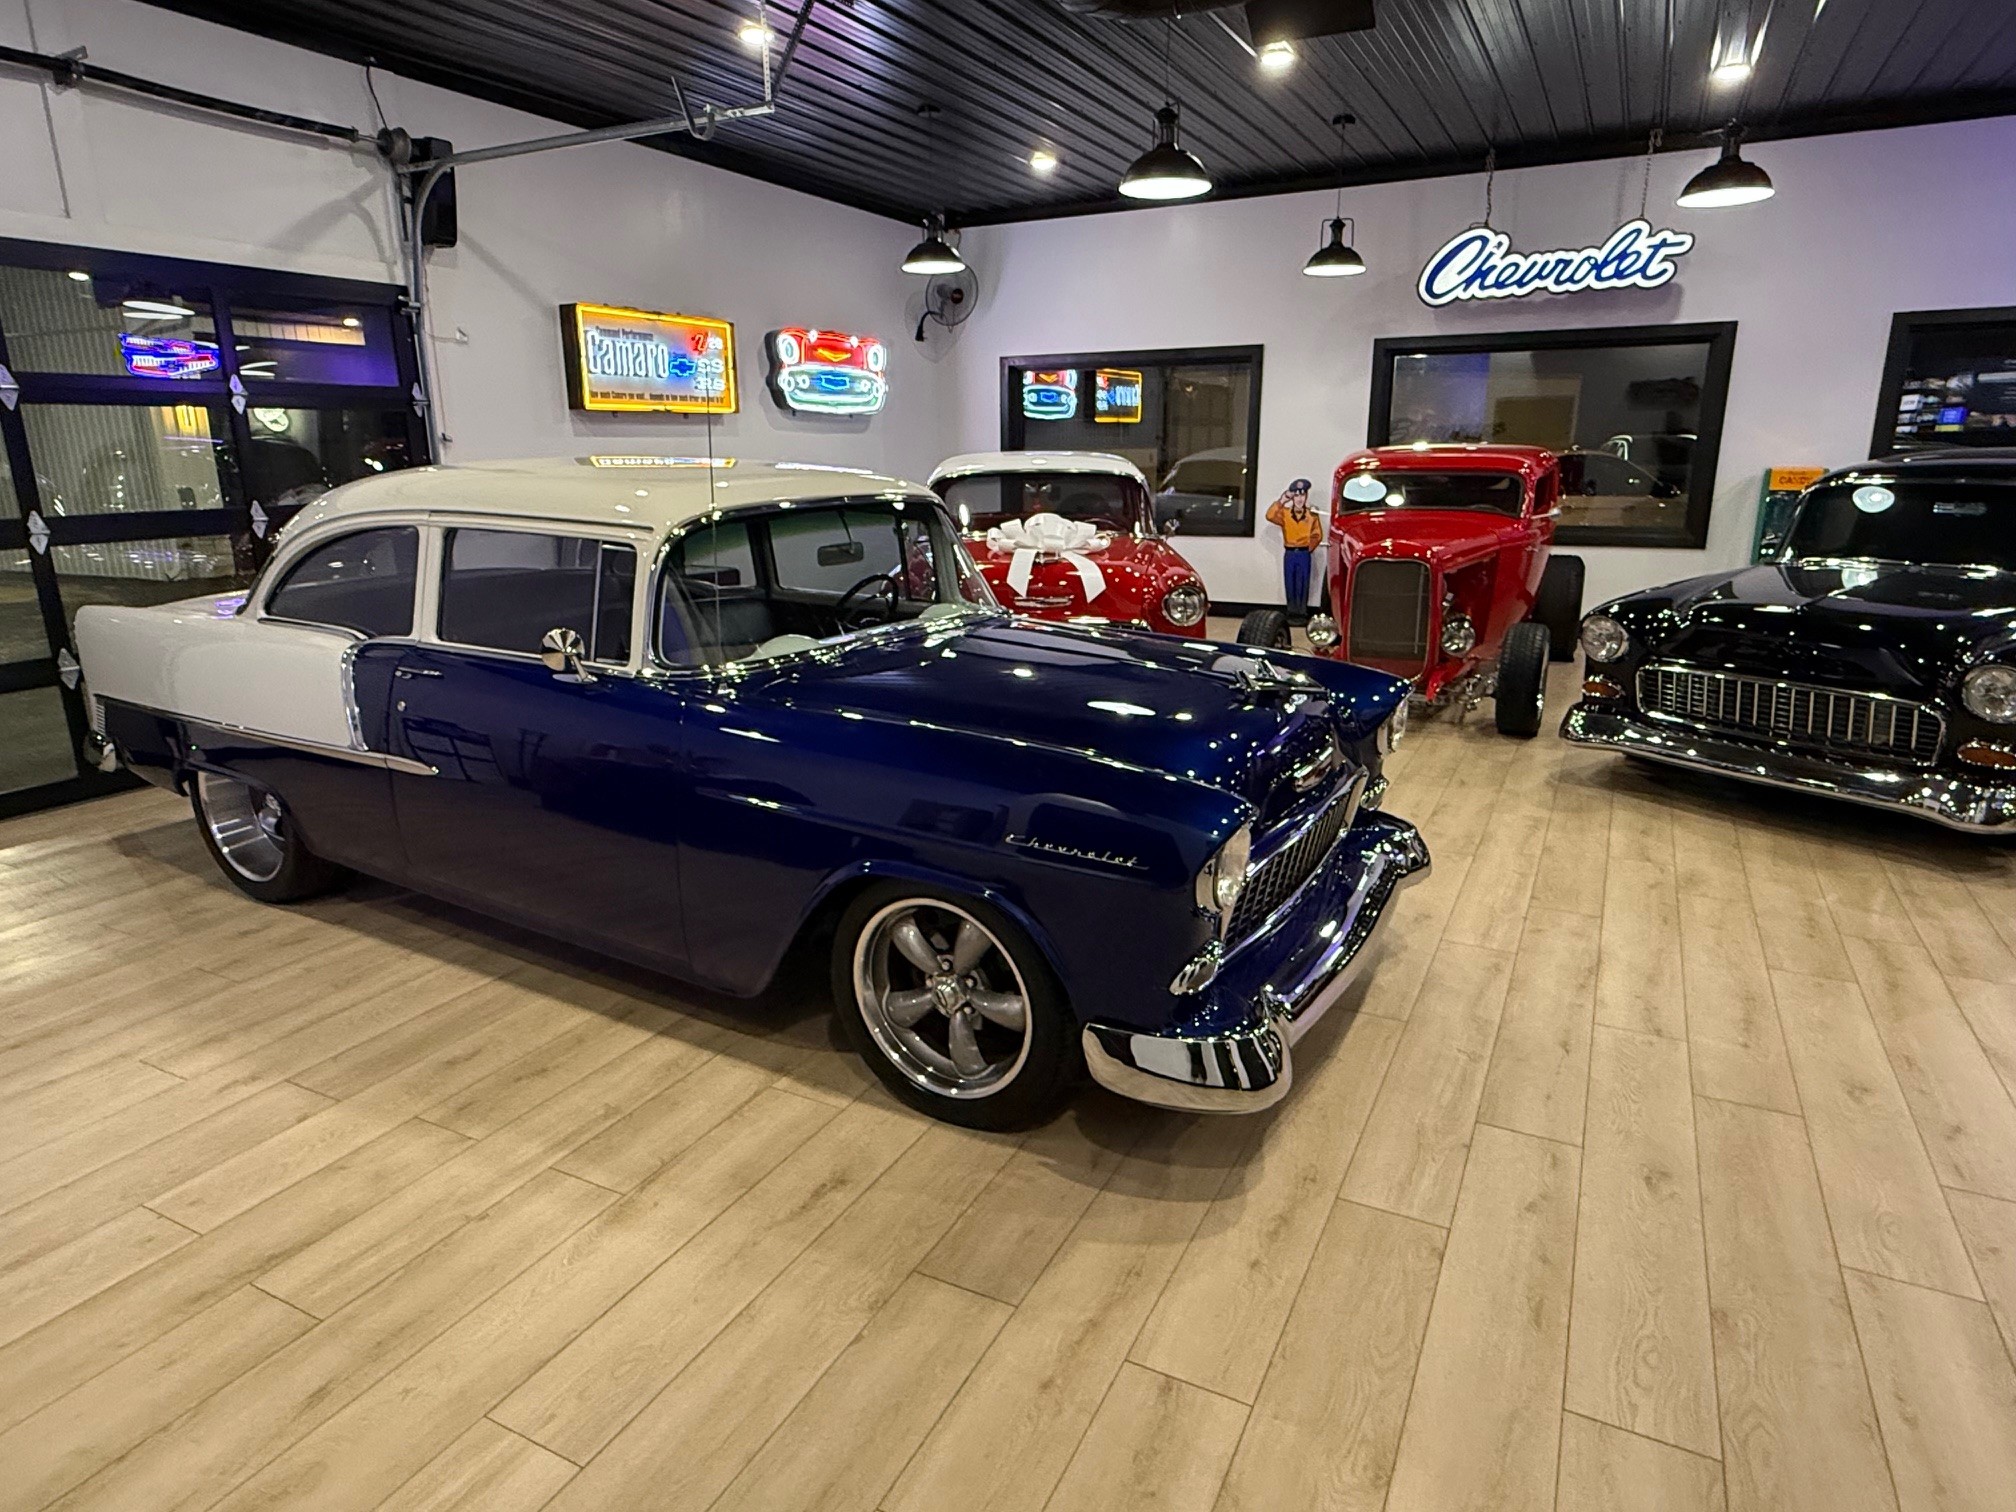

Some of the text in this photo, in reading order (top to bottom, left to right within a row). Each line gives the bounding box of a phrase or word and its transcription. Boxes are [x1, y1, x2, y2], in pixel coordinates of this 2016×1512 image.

[1423, 225, 1687, 301] Chevrolet
[586, 329, 669, 379] Camaro
[1005, 833, 1149, 870] Chevrolet
